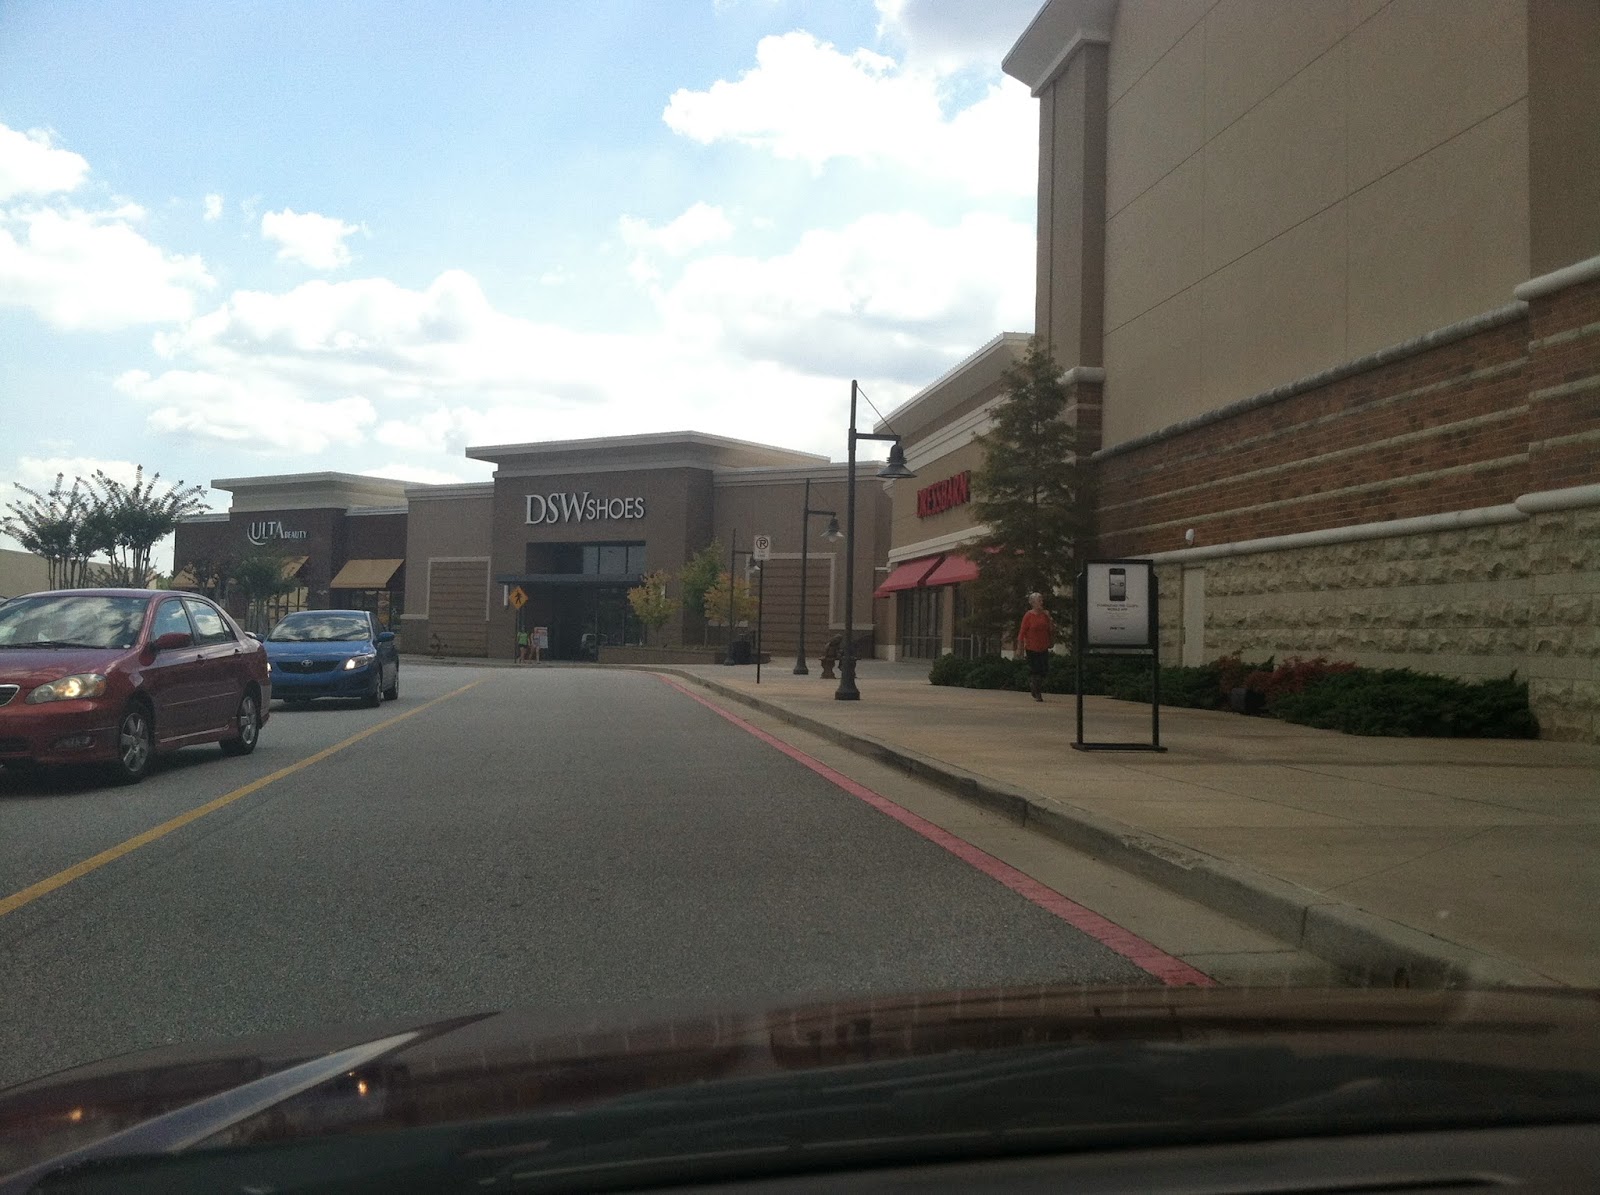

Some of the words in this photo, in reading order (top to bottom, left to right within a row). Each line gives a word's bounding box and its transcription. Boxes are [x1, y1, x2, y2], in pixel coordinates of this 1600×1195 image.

[524, 491, 590, 525] DSW
[585, 497, 645, 520] SHOES
[246, 521, 284, 546] ULTA
[284, 530, 308, 539] BEAUTY
